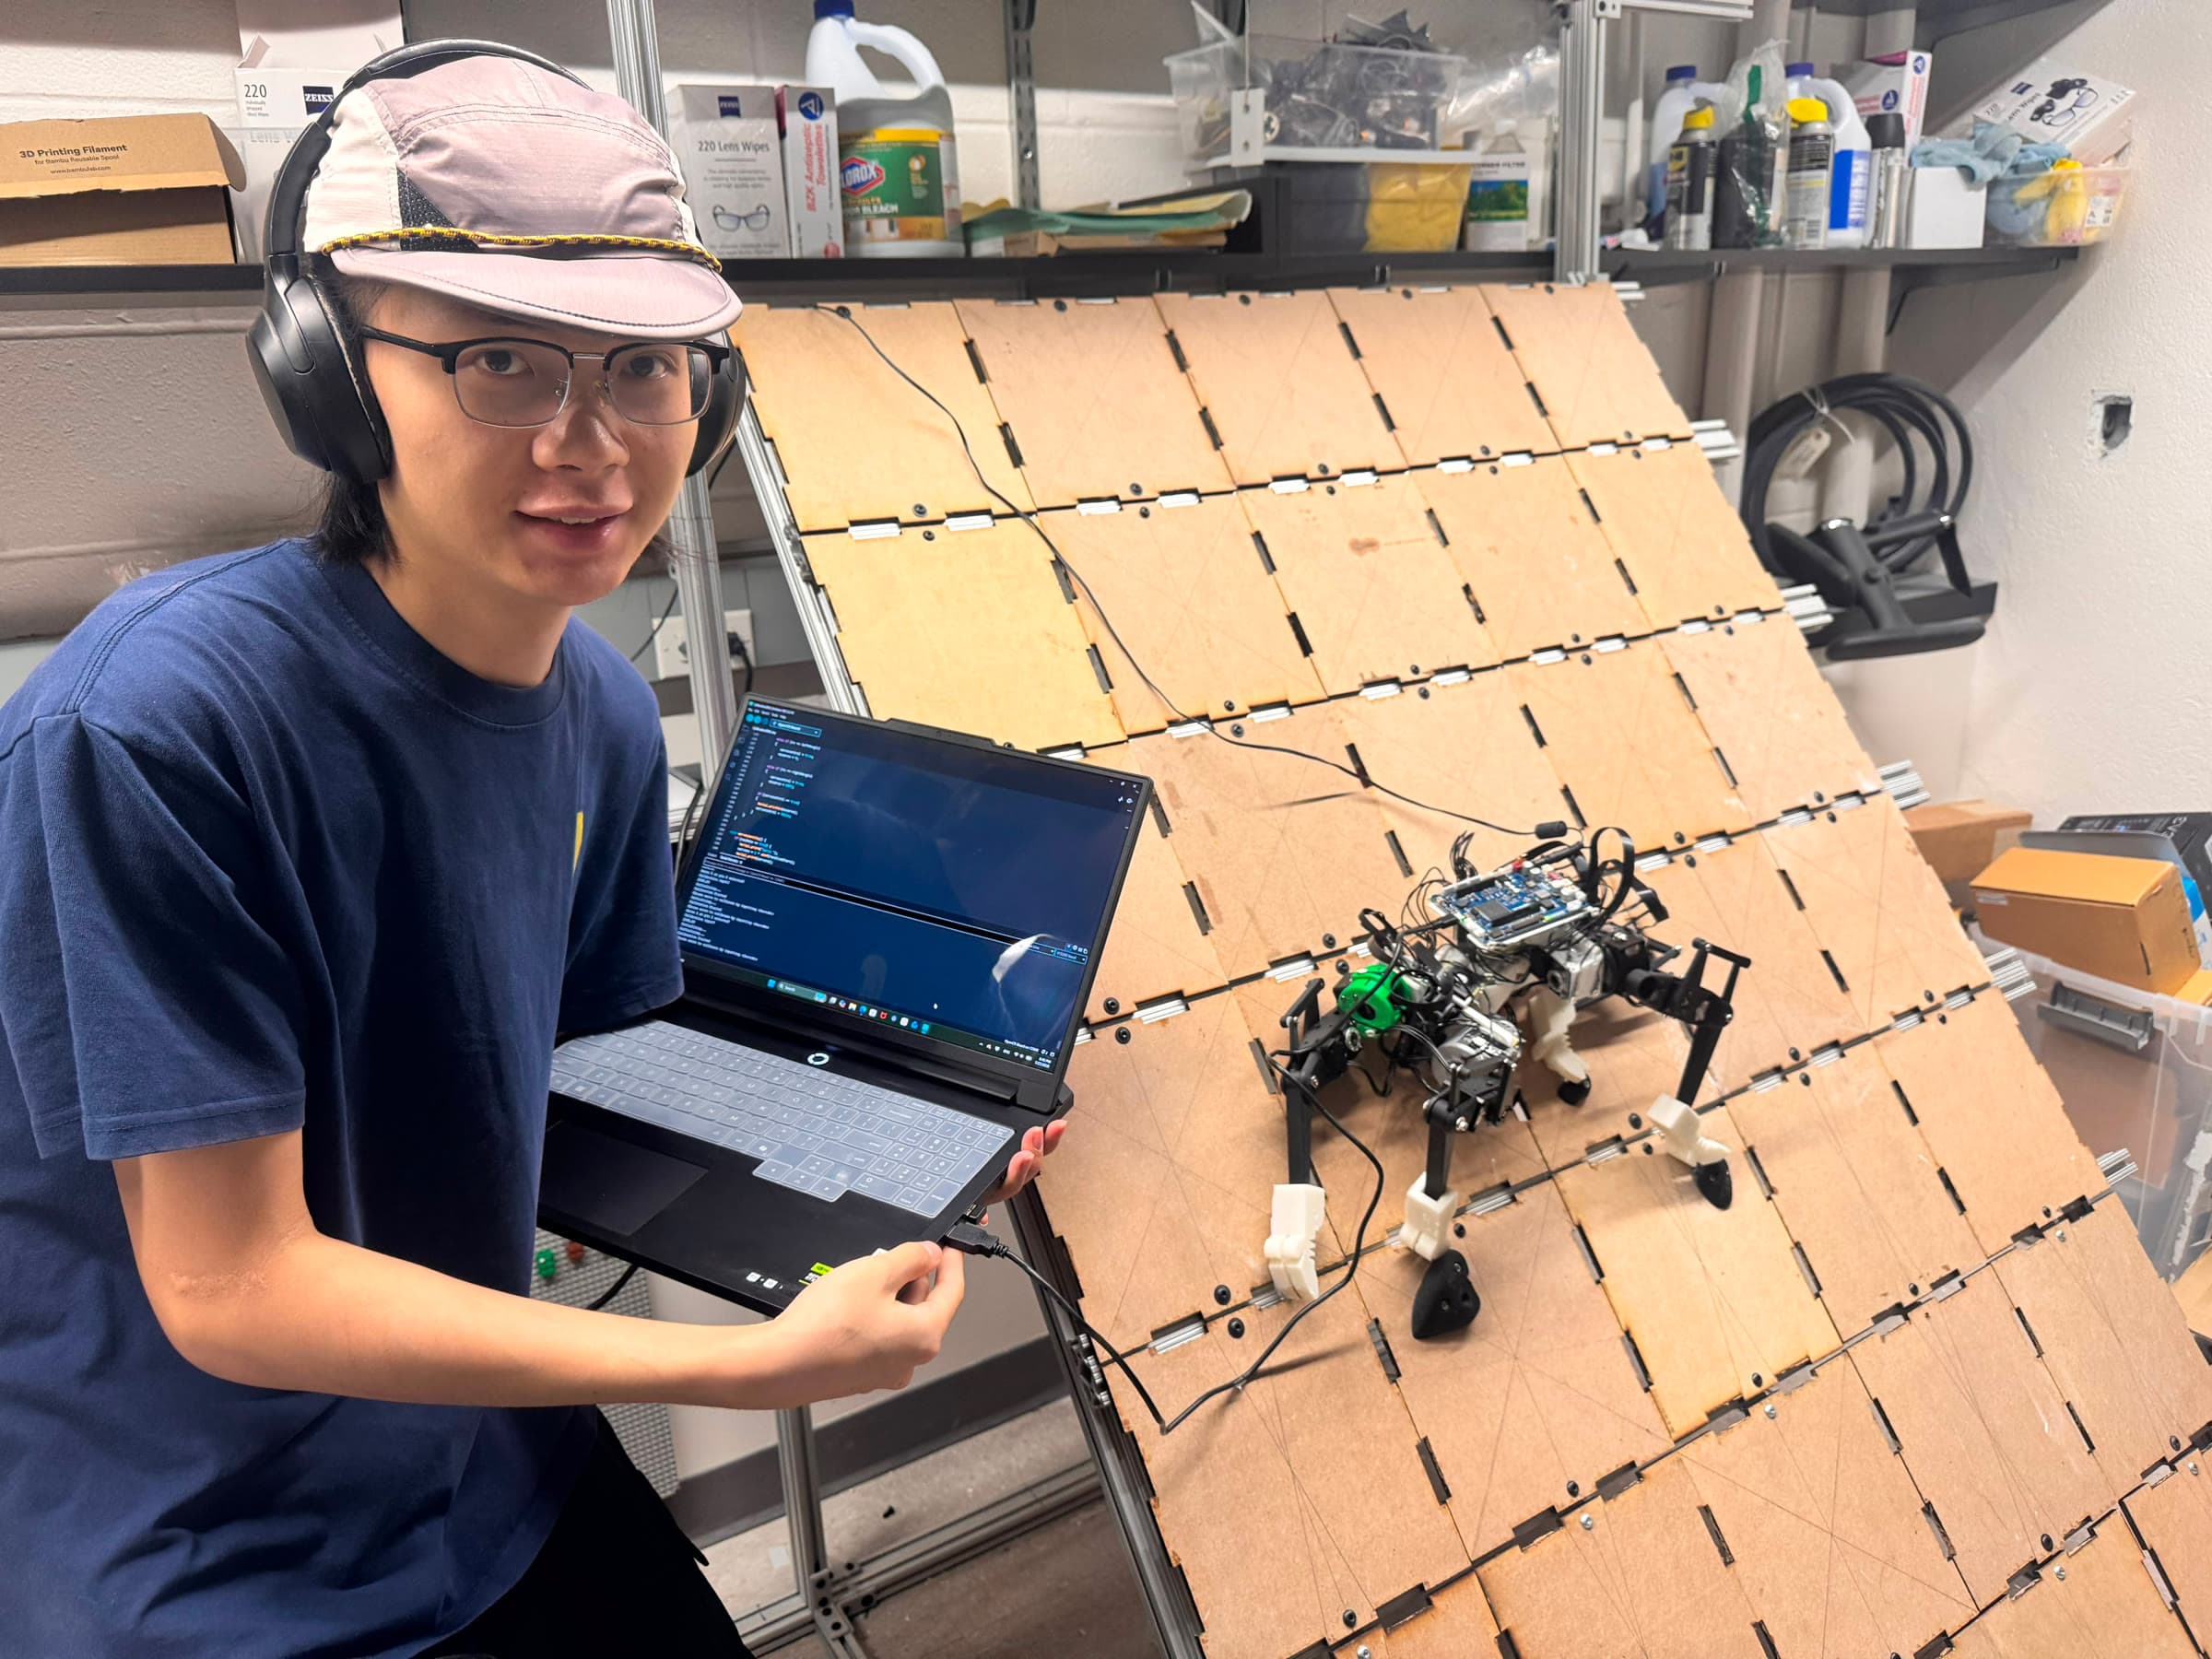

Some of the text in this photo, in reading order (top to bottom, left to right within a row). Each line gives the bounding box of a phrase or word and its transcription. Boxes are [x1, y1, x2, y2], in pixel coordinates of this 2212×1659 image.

[243, 84, 267, 98] 220
[304, 93, 334, 102] ZEISS
[19, 144, 128, 159] 3D Printing Filament
[698, 140, 771, 154] 220 Lens Wipes
[841, 160, 878, 188] LOROX
